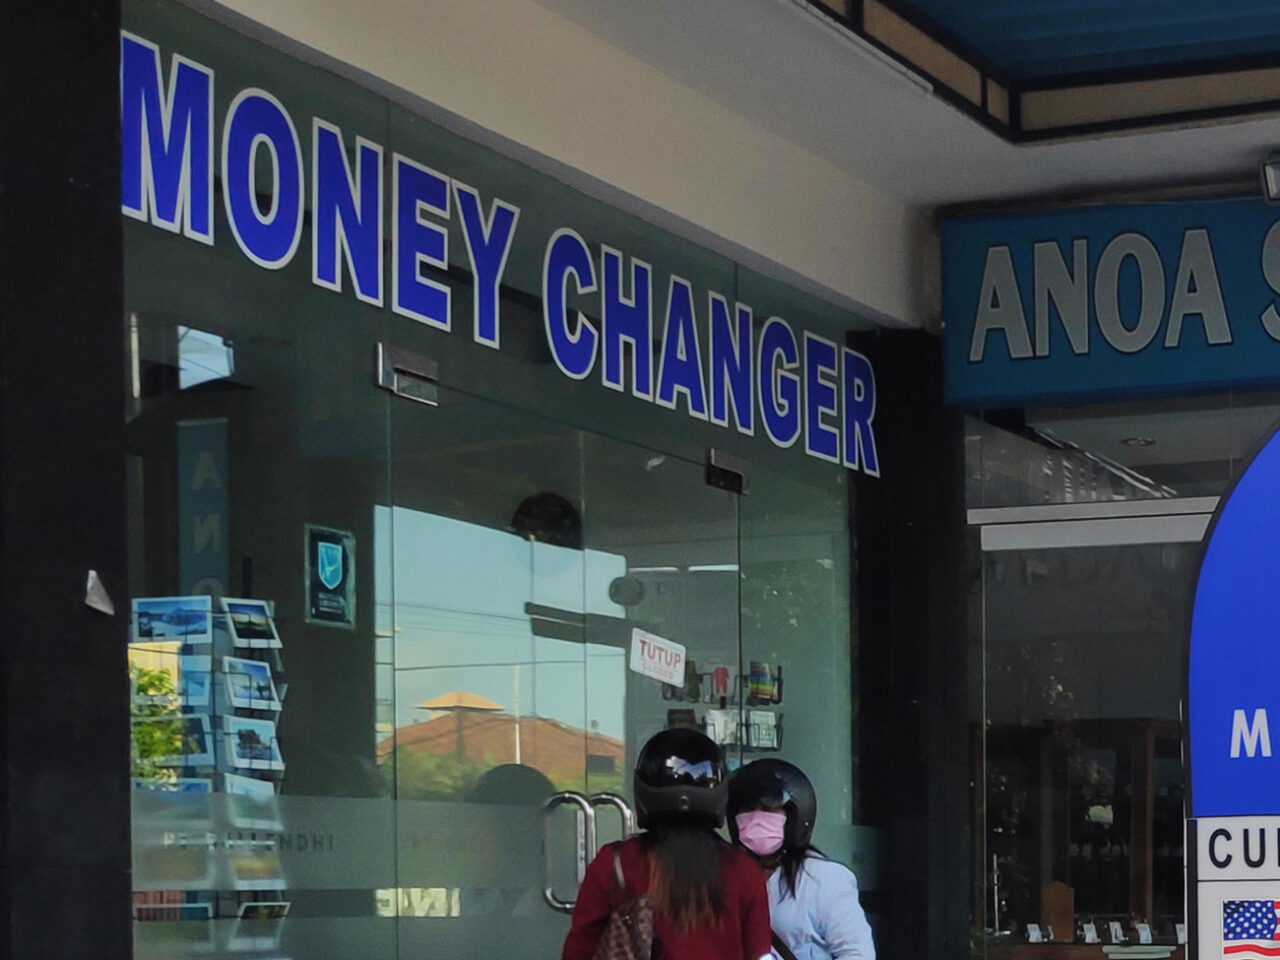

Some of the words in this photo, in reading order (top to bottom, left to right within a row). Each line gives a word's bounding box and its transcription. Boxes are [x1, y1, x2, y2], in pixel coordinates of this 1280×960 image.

[121, 30, 519, 349] MONEY
[542, 227, 880, 477] CHANGER
[968, 228, 1233, 361] ANOA
[639, 639, 681, 668] TUTUP
